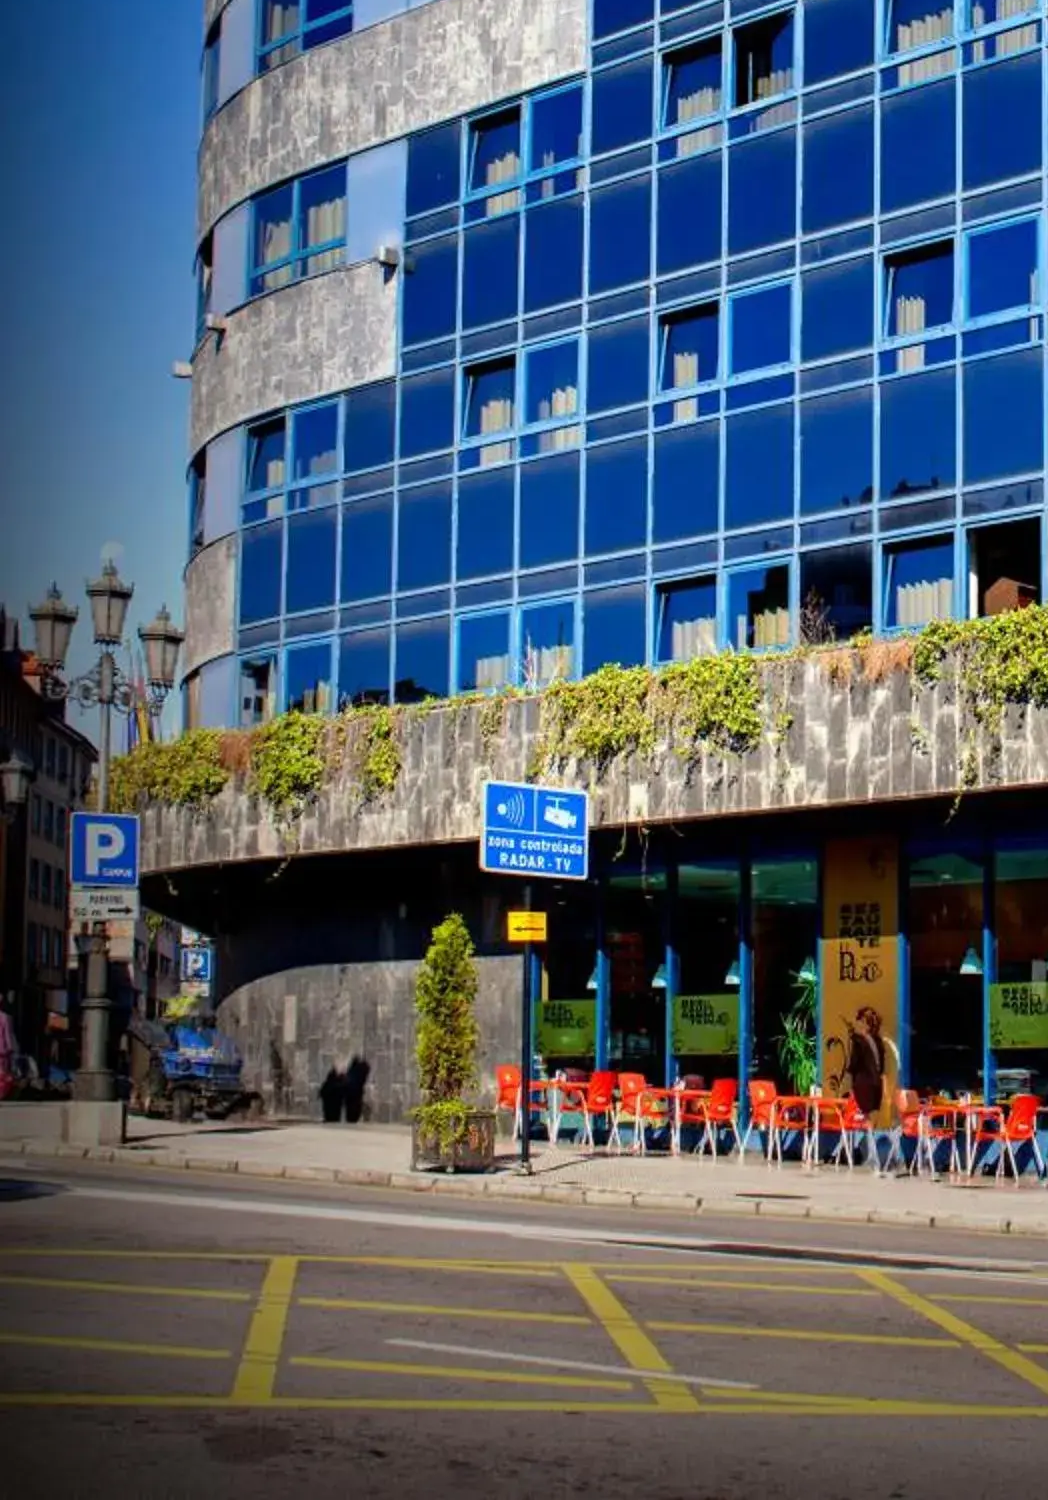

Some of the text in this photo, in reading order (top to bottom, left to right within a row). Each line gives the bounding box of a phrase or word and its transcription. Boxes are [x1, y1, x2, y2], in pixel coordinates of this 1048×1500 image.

[85, 823, 125, 876] P
[487, 835, 583, 855] zona controlada
